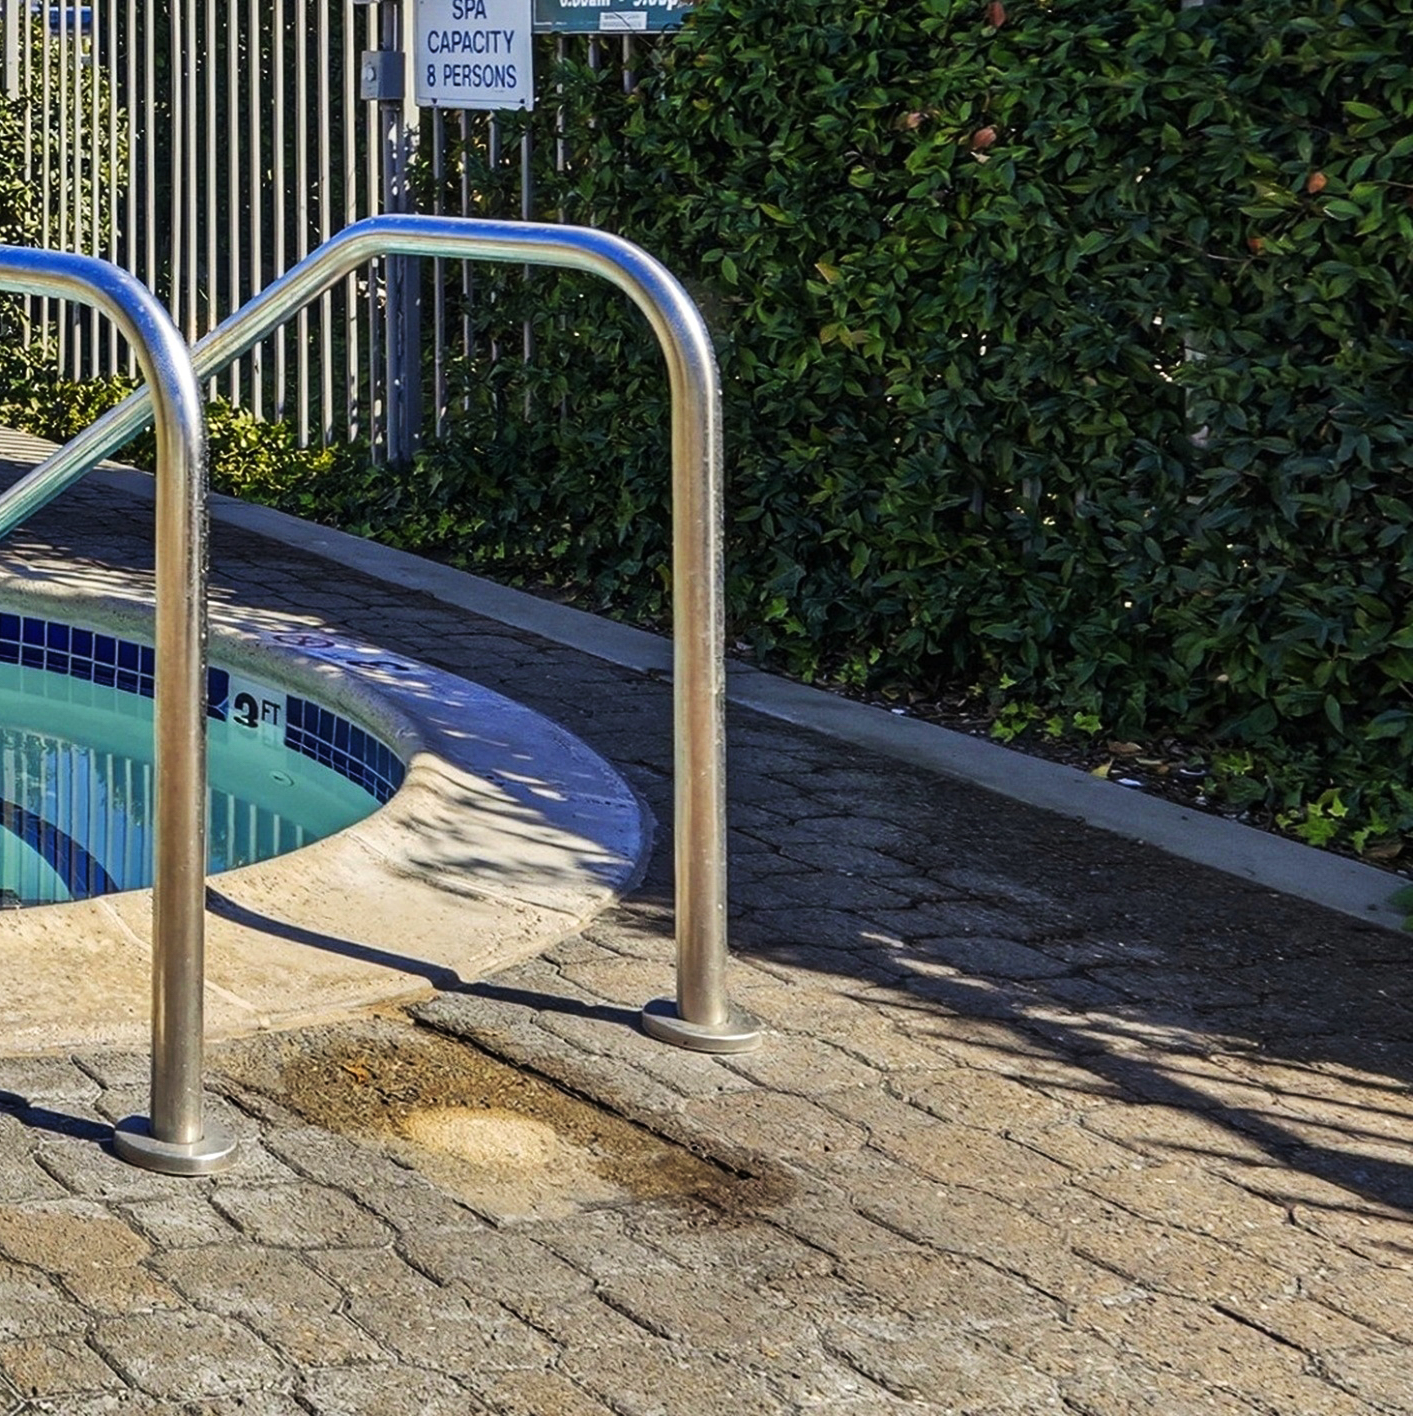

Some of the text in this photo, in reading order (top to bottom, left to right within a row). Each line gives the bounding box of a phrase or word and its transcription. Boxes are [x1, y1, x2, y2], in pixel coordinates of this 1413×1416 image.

[427, 30, 515, 54] CAPACITY
[426, 64, 517, 89] 8 PERSONS
[234, 691, 282, 728] 3 FT
